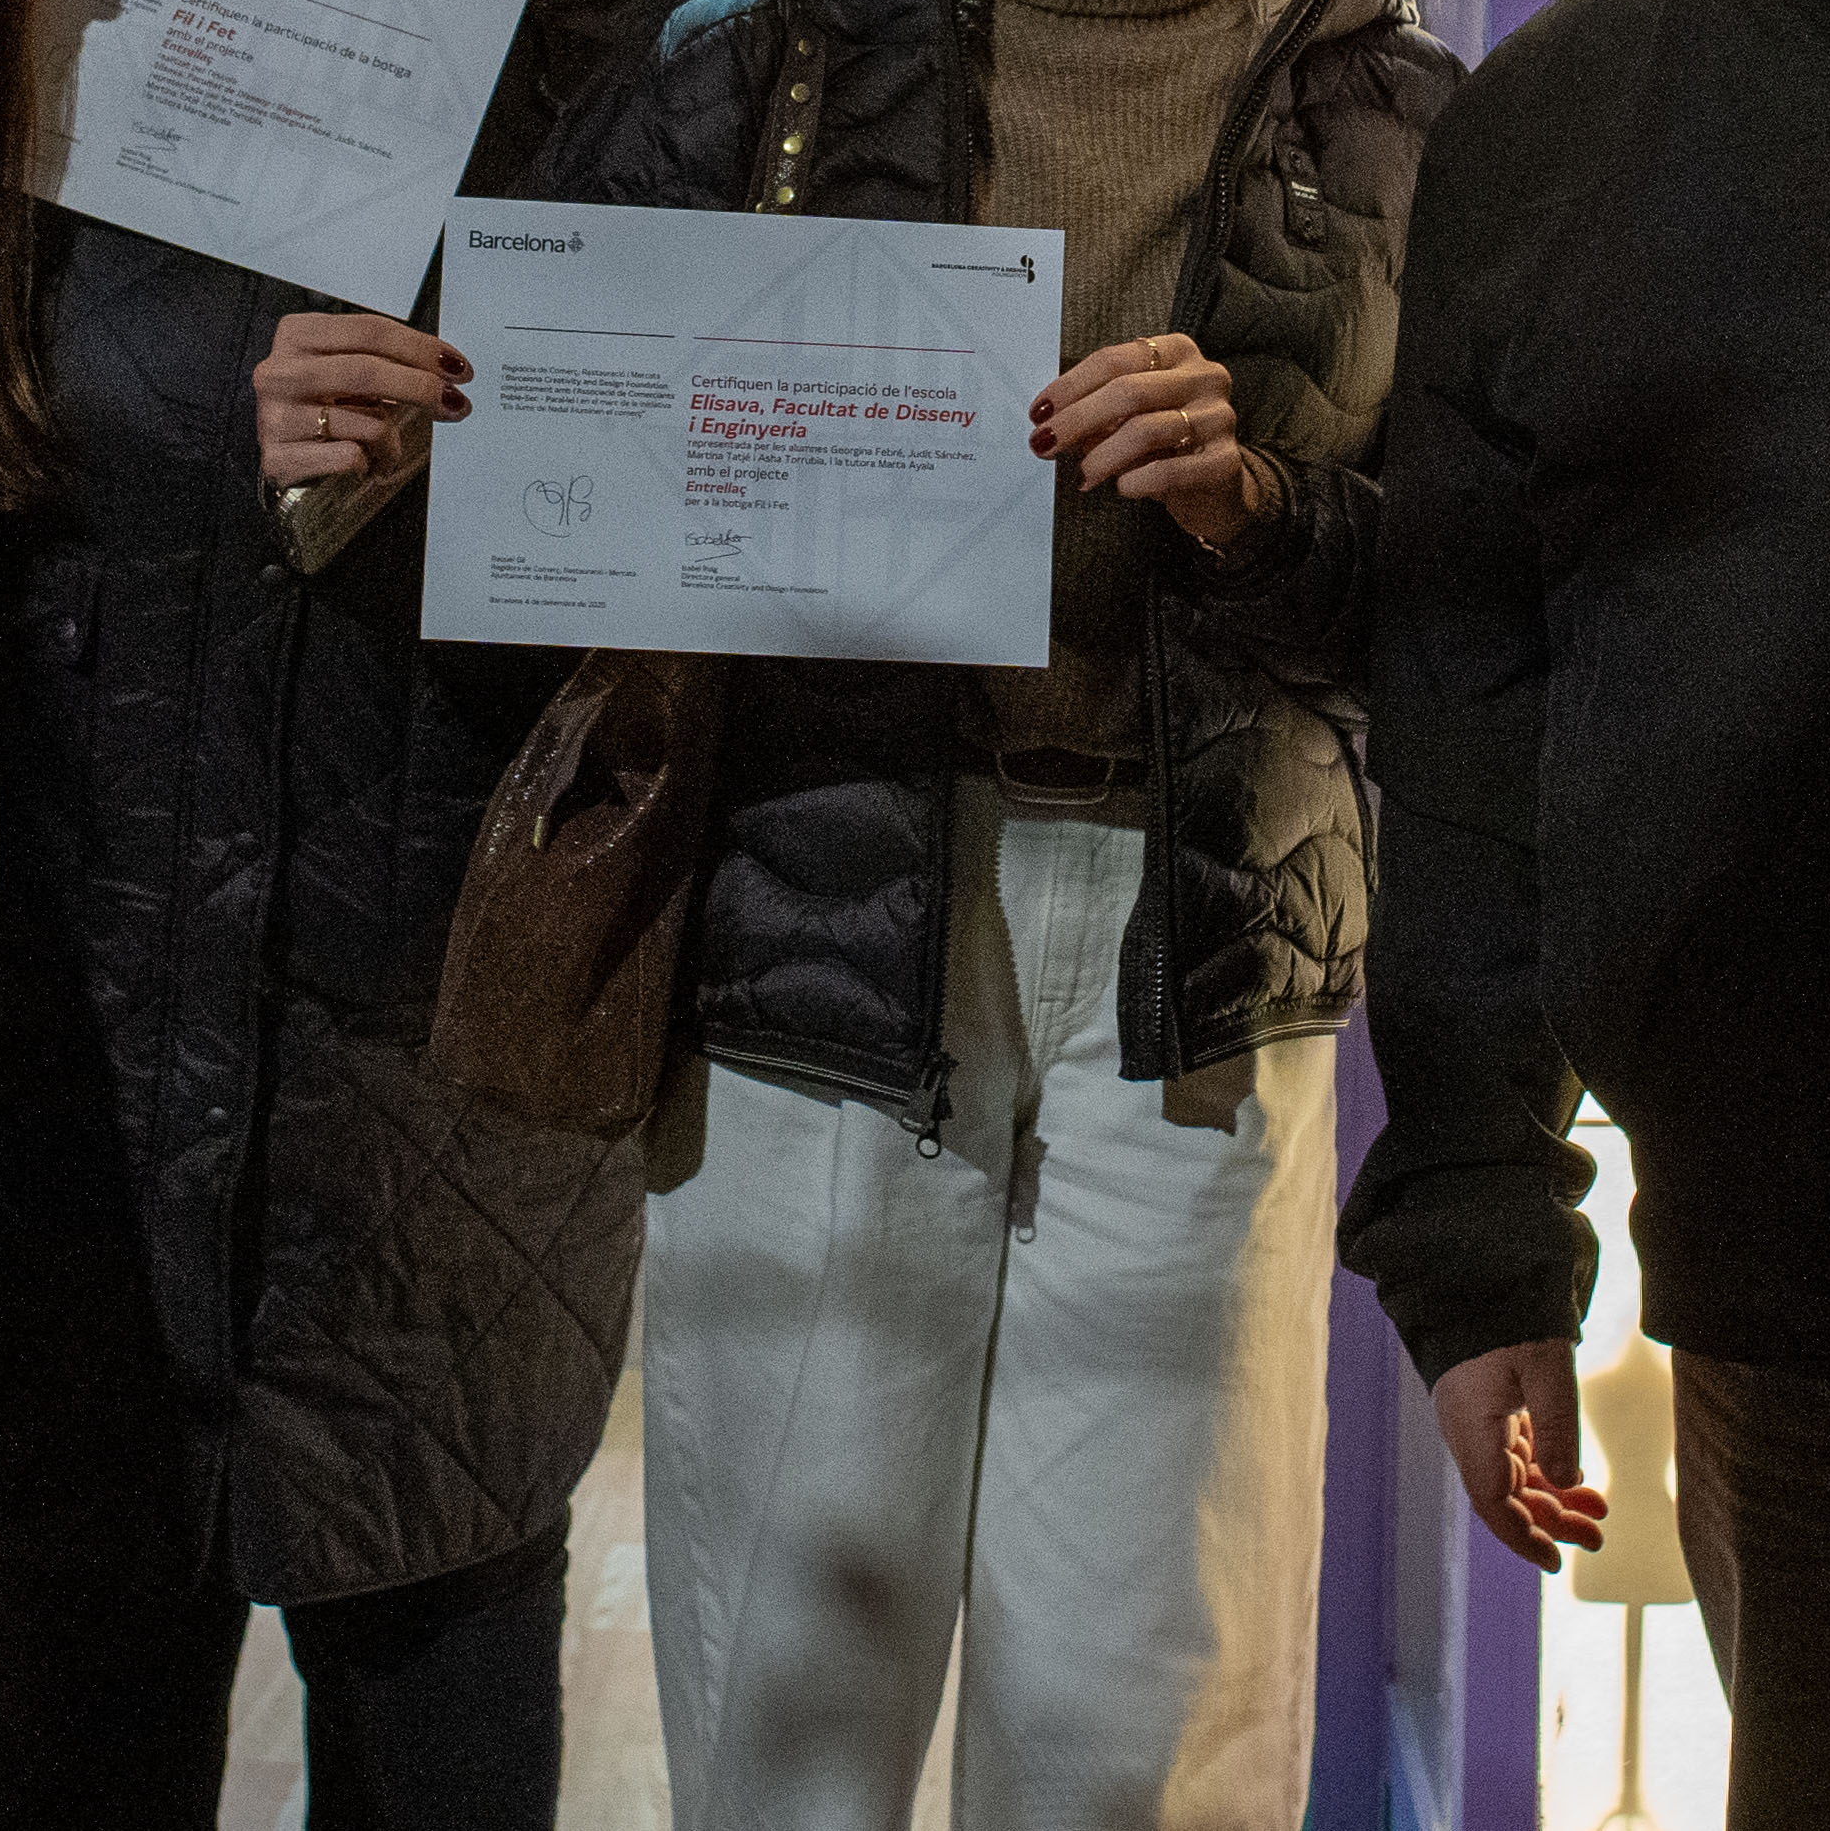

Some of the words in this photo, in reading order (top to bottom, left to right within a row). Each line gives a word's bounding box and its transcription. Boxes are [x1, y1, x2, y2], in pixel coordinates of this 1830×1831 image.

[171, 8, 194, 26] Fil
[196, 16, 204, 30] i
[205, 19, 237, 41] Fet
[165, 25, 192, 41] amb
[193, 34, 205, 45] el
[205, 38, 254, 64] projecte
[250, 15, 263, 28] la
[263, 20, 338, 56] participació
[339, 45, 357, 60] de
[357, 51, 370, 64] la
[370, 55, 412, 81] botiga
[468, 229, 566, 253] Barcelona
[691, 374, 773, 393] Certifiquen
[777, 378, 789, 391] la
[793, 379, 877, 398] participació
[882, 384, 900, 397] de
[903, 385, 957, 400] l'escola
[689, 393, 765, 416] Elisava,
[772, 397, 857, 417] Facultat
[864, 402, 889, 419] de
[895, 404, 976, 427] Disseny
[688, 416, 695, 432] i
[701, 417, 807, 442] Enginyeria
[688, 438, 751, 451] representada
[754, 444, 769, 452] per
[772, 442, 786, 451] les
[788, 443, 827, 453] alumnes
[830, 445, 872, 457] Georgina
[908, 449, 931, 458] Judit
[686, 464, 716, 476] amb
[719, 466, 730, 477] el
[734, 467, 789, 483] projecte
[685, 480, 746, 497] Entrellaç
[684, 498, 700, 507] per
[711, 498, 721, 506] la
[723, 498, 752, 509] botiga
[754, 500, 766, 508] Fil
[773, 501, 789, 509] Fet
